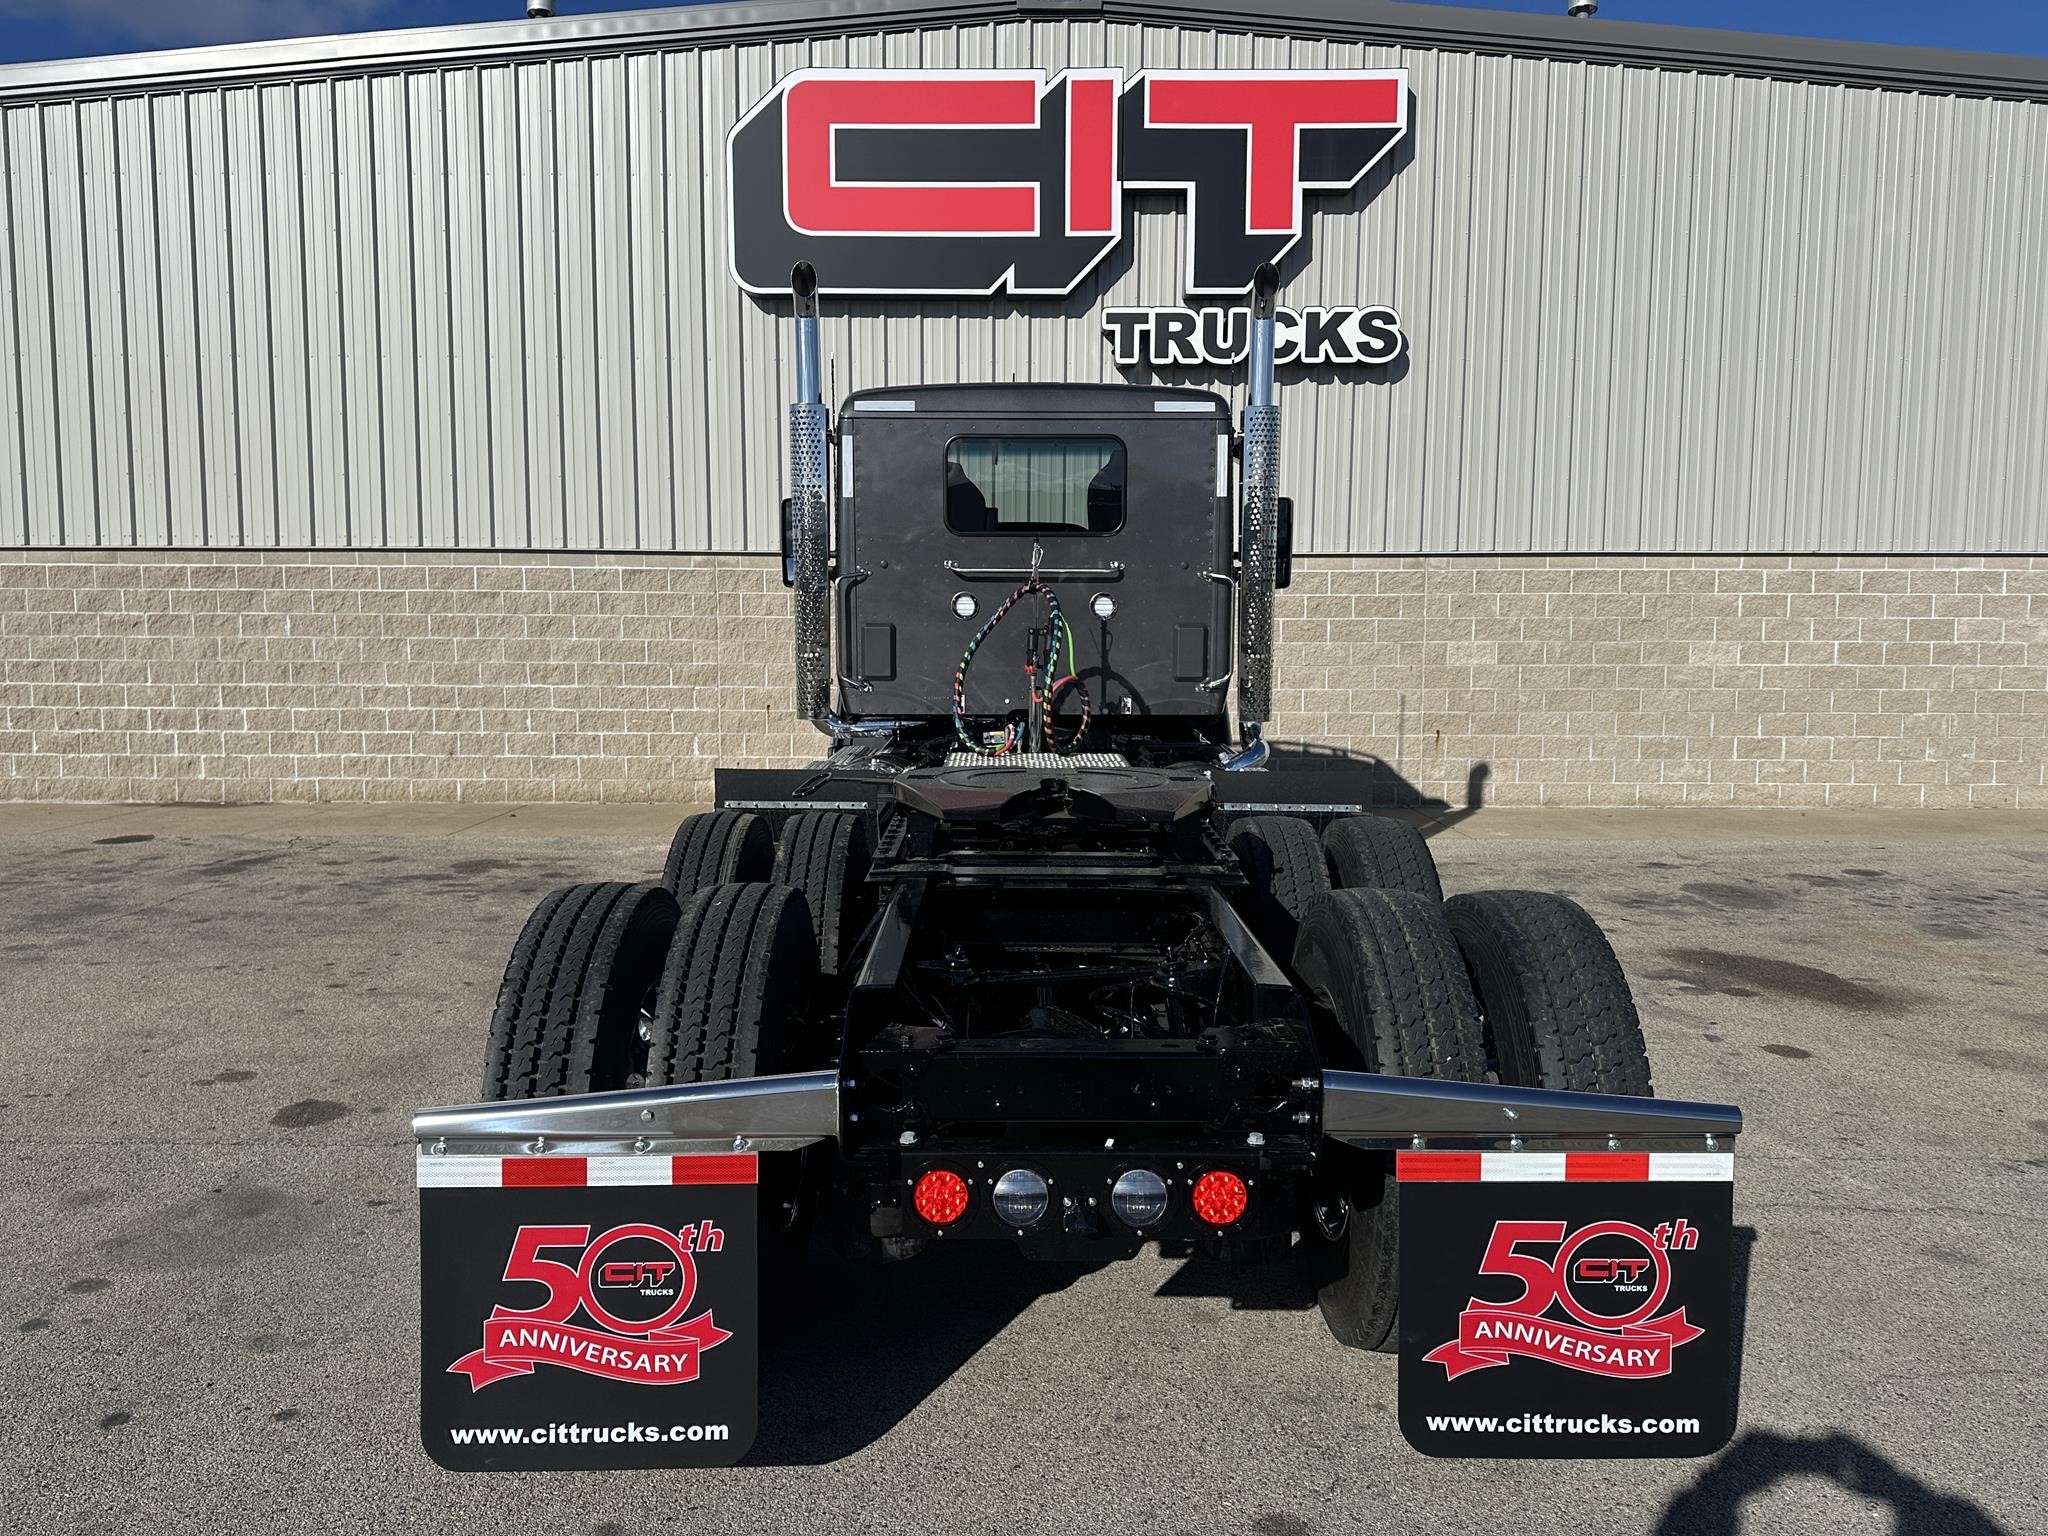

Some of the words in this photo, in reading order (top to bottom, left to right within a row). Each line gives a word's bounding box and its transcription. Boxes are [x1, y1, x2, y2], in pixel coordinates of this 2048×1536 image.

[782, 68, 1408, 237] CIT
[1104, 308, 1400, 362] TRUCKS
[604, 1262, 675, 1282] CIT
[1578, 1259, 1649, 1278] CIT
[640, 1288, 674, 1296] TRUCKS
[499, 1328, 688, 1373] ANNIVERSARY
[1475, 1321, 1661, 1368] ANNIVERSARY
[450, 1422, 729, 1445] www.cittrucks.com
[1426, 1414, 1700, 1434] www.cittrucks.com
